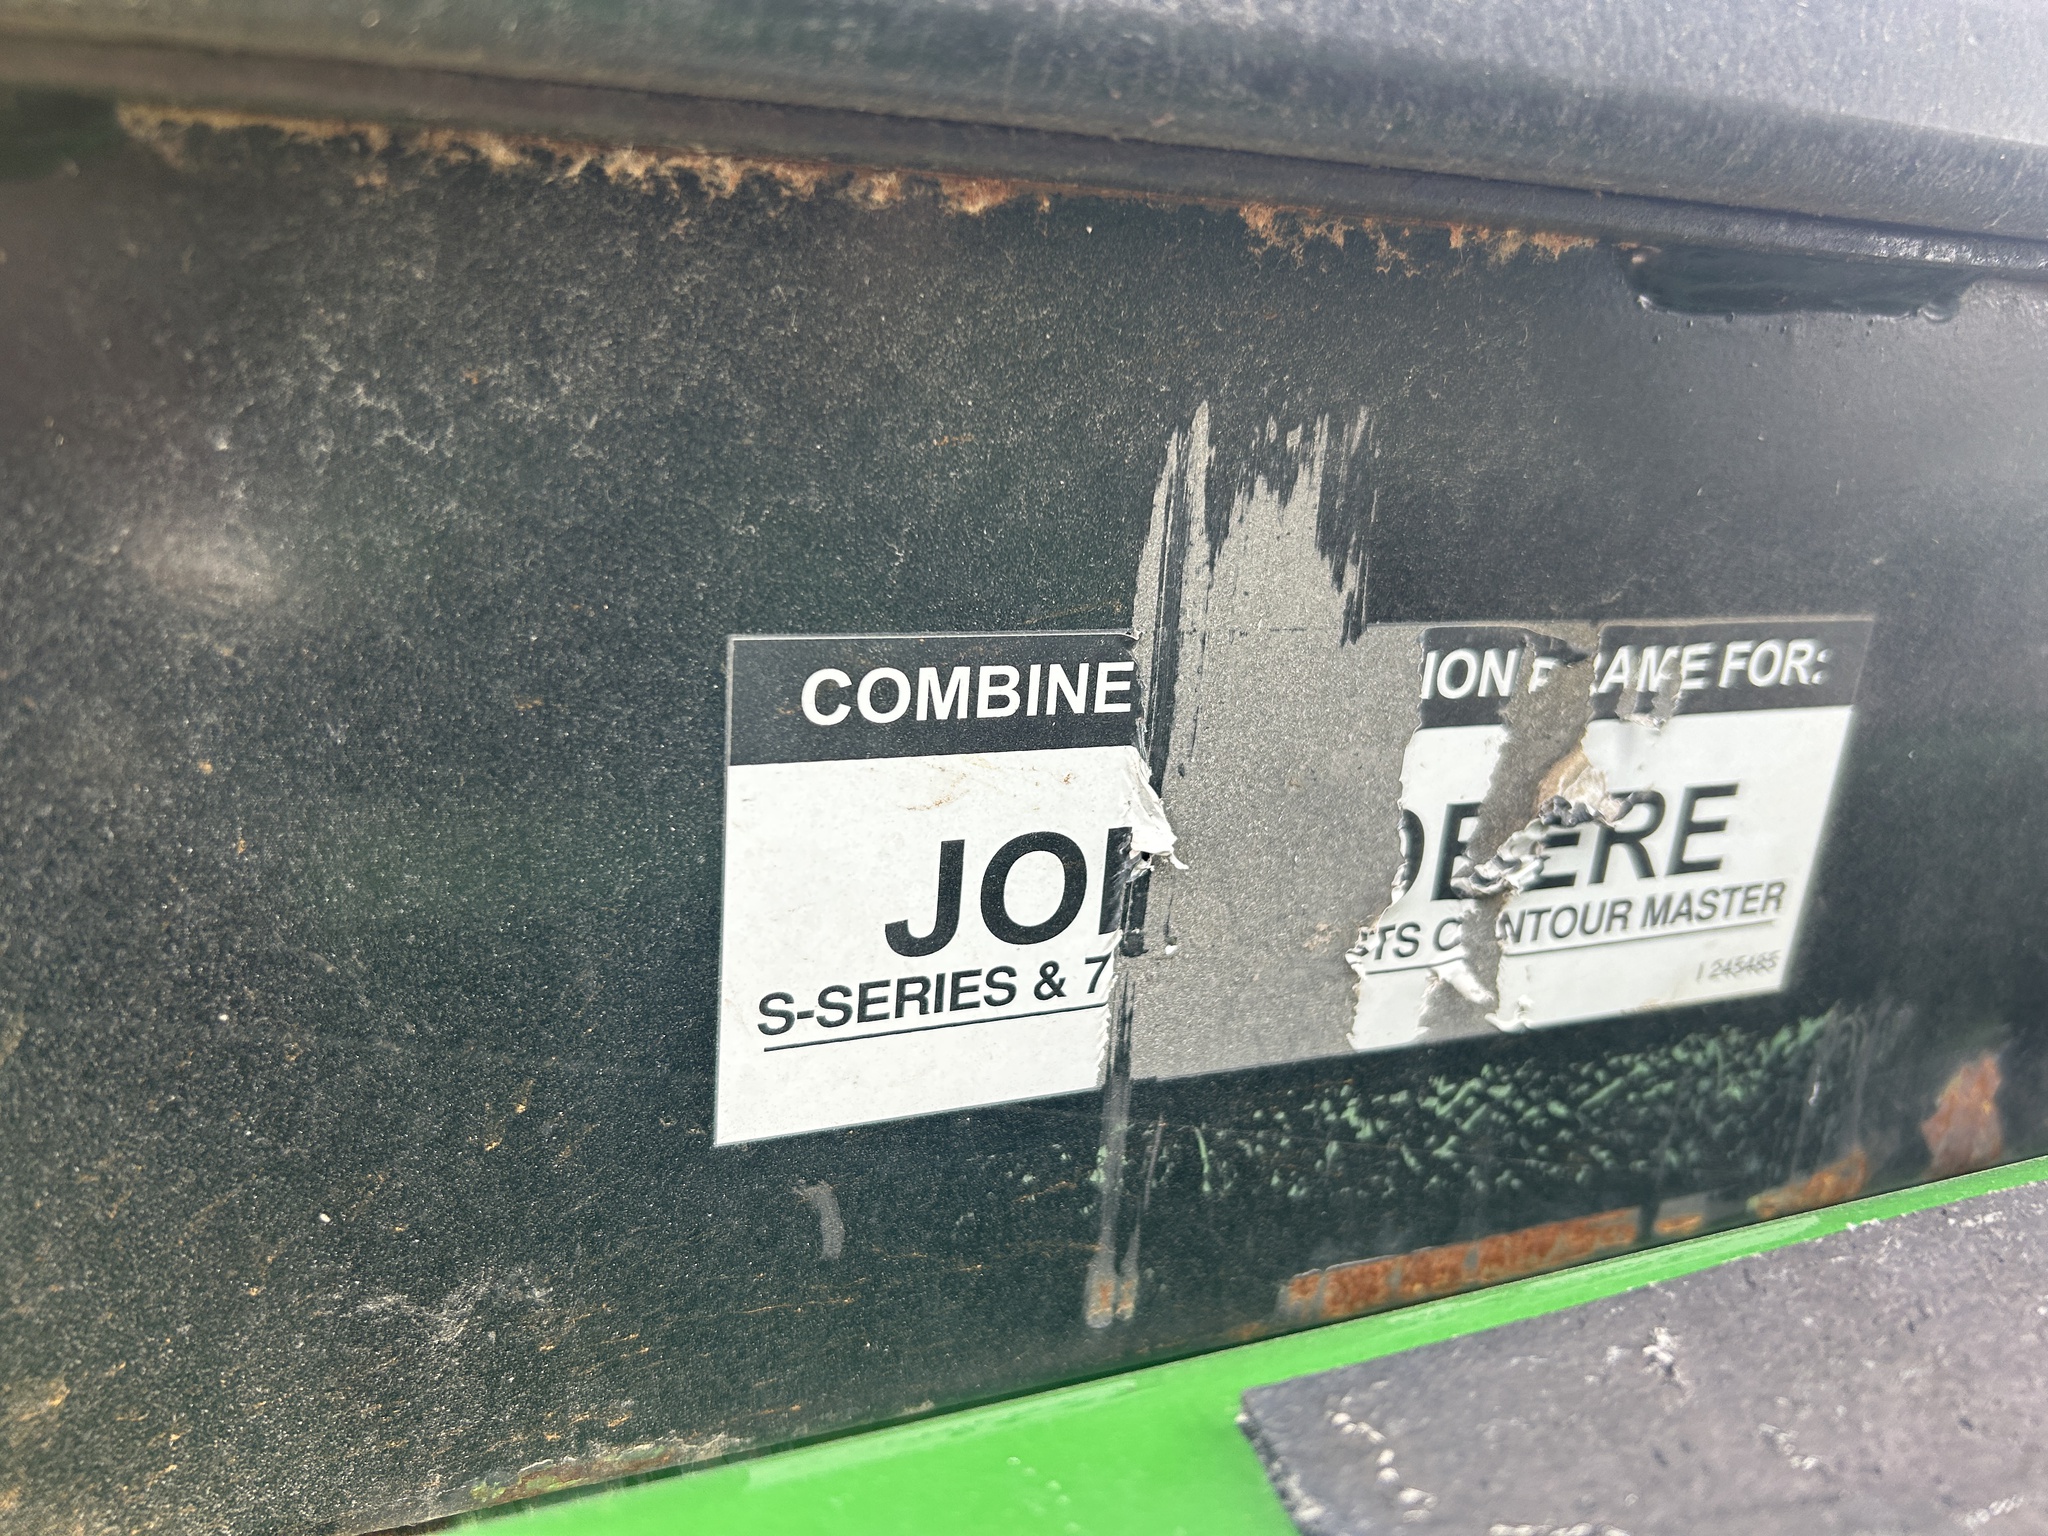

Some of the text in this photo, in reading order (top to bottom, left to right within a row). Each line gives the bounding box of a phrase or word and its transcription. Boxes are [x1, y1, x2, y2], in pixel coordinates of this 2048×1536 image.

[801, 661, 1135, 727] COMBINE
[1528, 641, 1715, 694] FAME
[1718, 637, 1833, 688] FOR:
[757, 964, 1018, 1037] S-SERIES
[1033, 959, 1066, 1001] &
[1432, 898, 1634, 952] CNTOUR
[1640, 880, 1786, 926] MASTER
